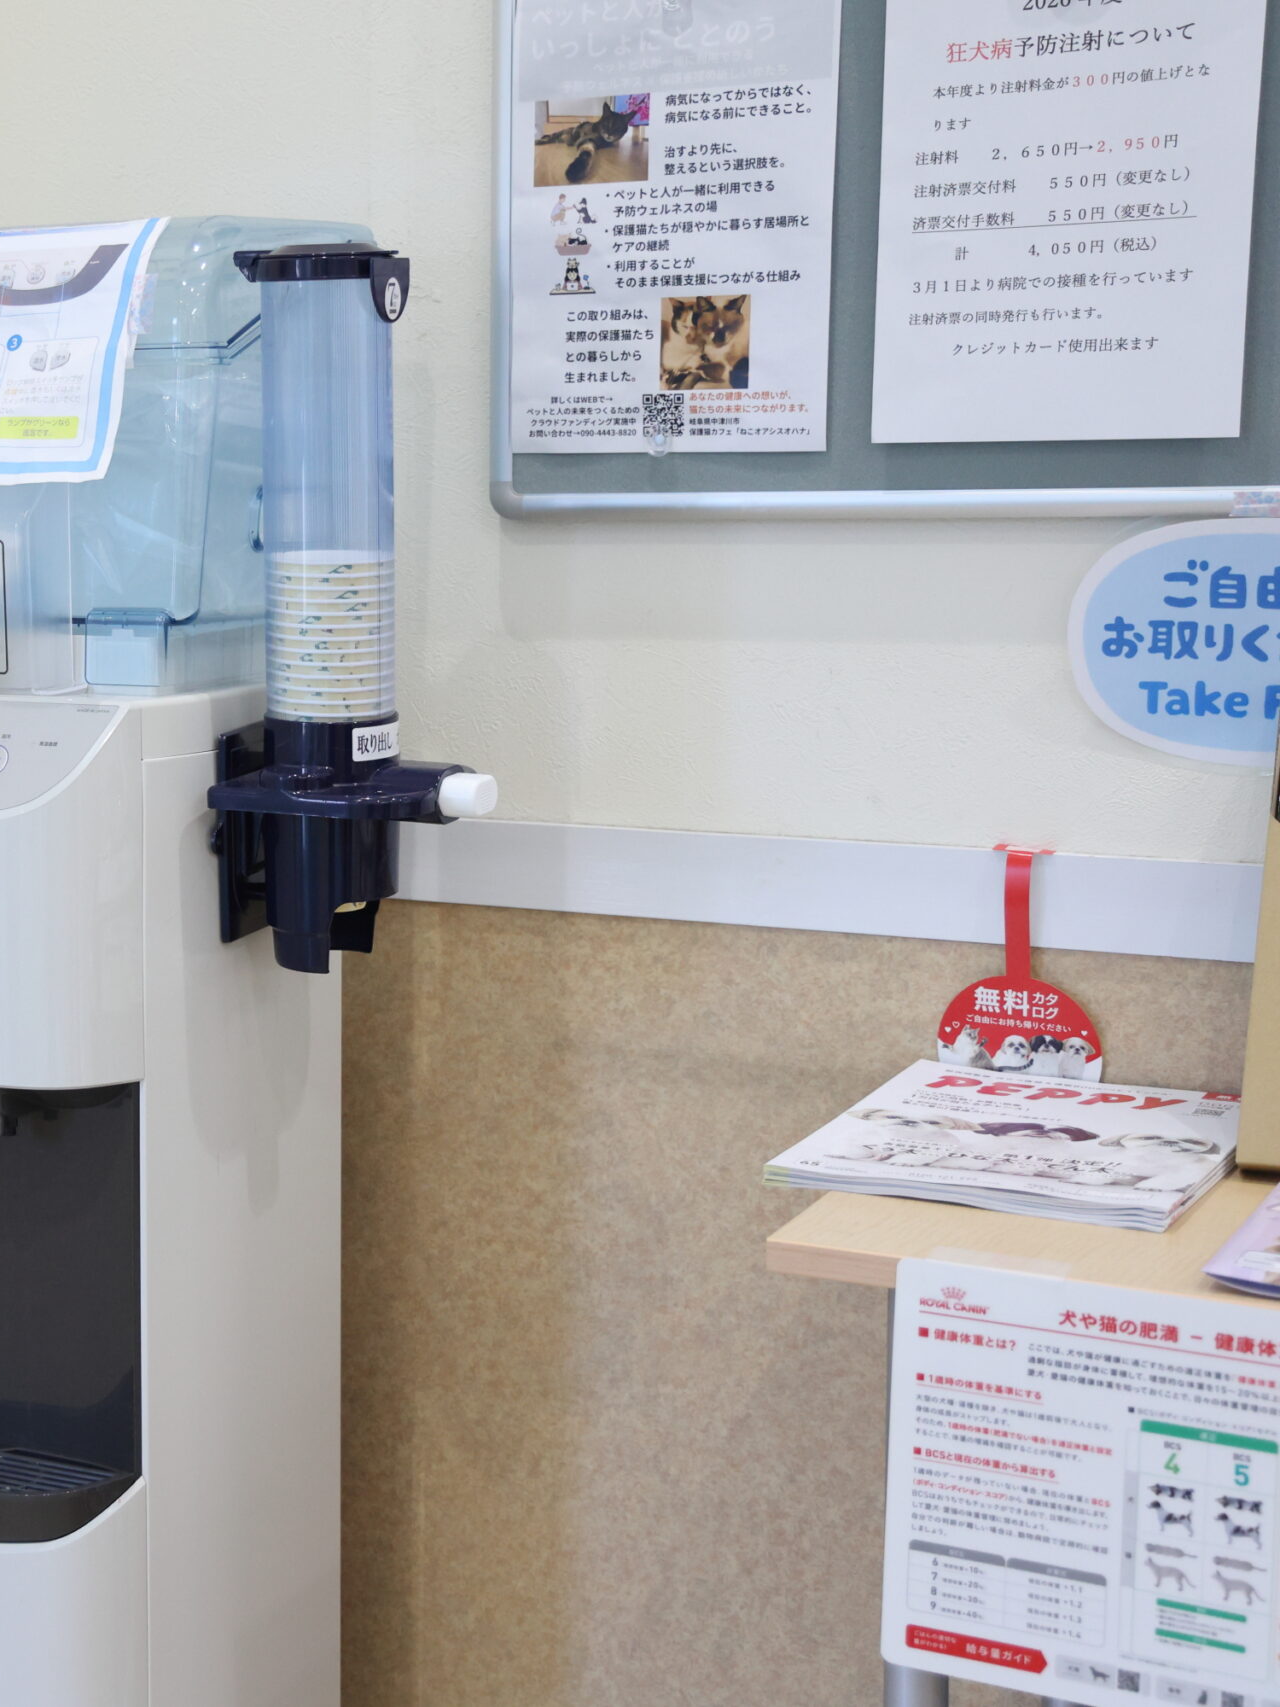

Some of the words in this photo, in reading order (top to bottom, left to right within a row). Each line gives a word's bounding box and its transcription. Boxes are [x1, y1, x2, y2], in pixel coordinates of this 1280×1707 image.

[946, 22, 1196, 63] 狂犬病予防注射について
[933, 64, 1210, 99] 本年度より注射料金が300円の値上げとな
[665, 84, 811, 106] 病気になってからではなく、
[665, 102, 811, 123] 病気になる前にできること。
[933, 117, 971, 132] ります
[664, 142, 737, 158] 治すより先に、
[915, 150, 959, 166] 注射料
[664, 156, 784, 175] 整えるという選択肢を。
[914, 179, 1016, 198] 注射済票交付料
[613, 201, 717, 218] 予防ウェルネスの場
[913, 212, 1014, 231] 済票交付手数料
[612, 239, 669, 254] ケアの継続
[954, 246, 969, 261] 計
[615, 270, 801, 288] そのまま保護支援につながる仕組み
[913, 268, 1194, 294] 3月1日より病院での接種を行っています
[567, 309, 648, 322] この取り組みは、
[909, 306, 1103, 326] 注射済票の同時発行も行います。
[565, 329, 655, 343] 実際の保護猫たち
[952, 336, 1159, 356] クレジットカード使用出来ます
[566, 350, 642, 362] との暮らしから
[564, 371, 636, 383] 生まれました。
[526, 406, 640, 416] ペットと人の未来をつくるための
[689, 403, 808, 414] 猫たちの未来につながります。
[531, 417, 637, 427] クラウドファンディング実施中
[689, 417, 740, 426] 岐阜県中津川市
[1102, 616, 1280, 662] お取りく
[1138, 681, 1249, 718] Take
[357, 731, 400, 755] 取り出し
[974, 986, 1030, 1017] 無料
[965, 1014, 1072, 1033] ご自由にお持ち帰りください
[925, 1075, 1189, 1111] PEPPY
[919, 1297, 950, 1310] ROYAL
[952, 1304, 987, 1316] CANIN
[934, 1328, 1017, 1350] 健康体重とは?
[1058, 1309, 1179, 1344] 犬や猫の肥満
[1214, 1332, 1280, 1357] 健康体
[1164, 1453, 1181, 1475] 4
[1234, 1464, 1250, 1486] 5
[966, 1643, 1032, 1665] 給与量ガイド
